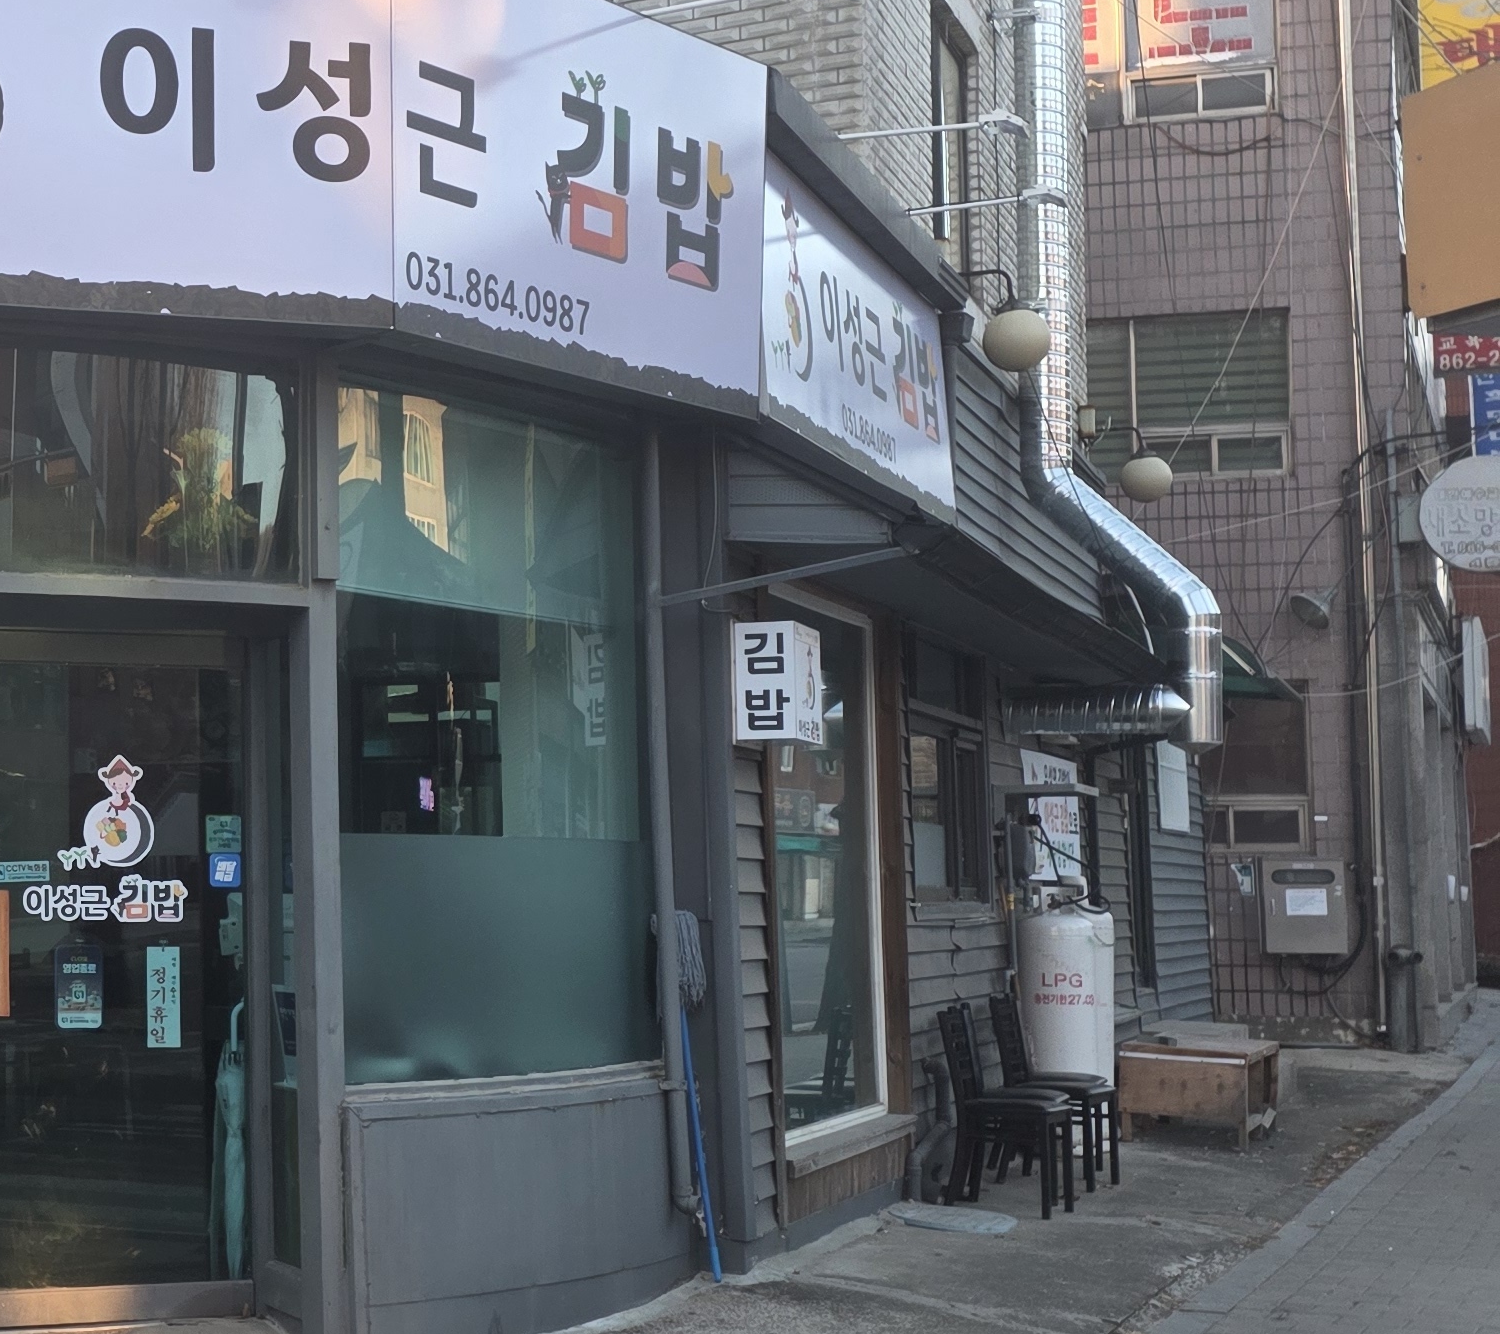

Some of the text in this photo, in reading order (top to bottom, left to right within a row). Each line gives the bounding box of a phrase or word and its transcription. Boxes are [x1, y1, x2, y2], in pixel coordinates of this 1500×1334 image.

[100, 26, 734, 293] 이성근 김밥
[405, 251, 591, 336] 031.864.0987
[820, 270, 940, 445] 이성근 김밥
[841, 402, 897, 464] 031.864.0987
[743, 632, 791, 731] 김밥
[25, 878, 186, 921] 이성근 김밥
[150, 966, 168, 1044] 정기휴일
[1041, 972, 1083, 989] LPG
